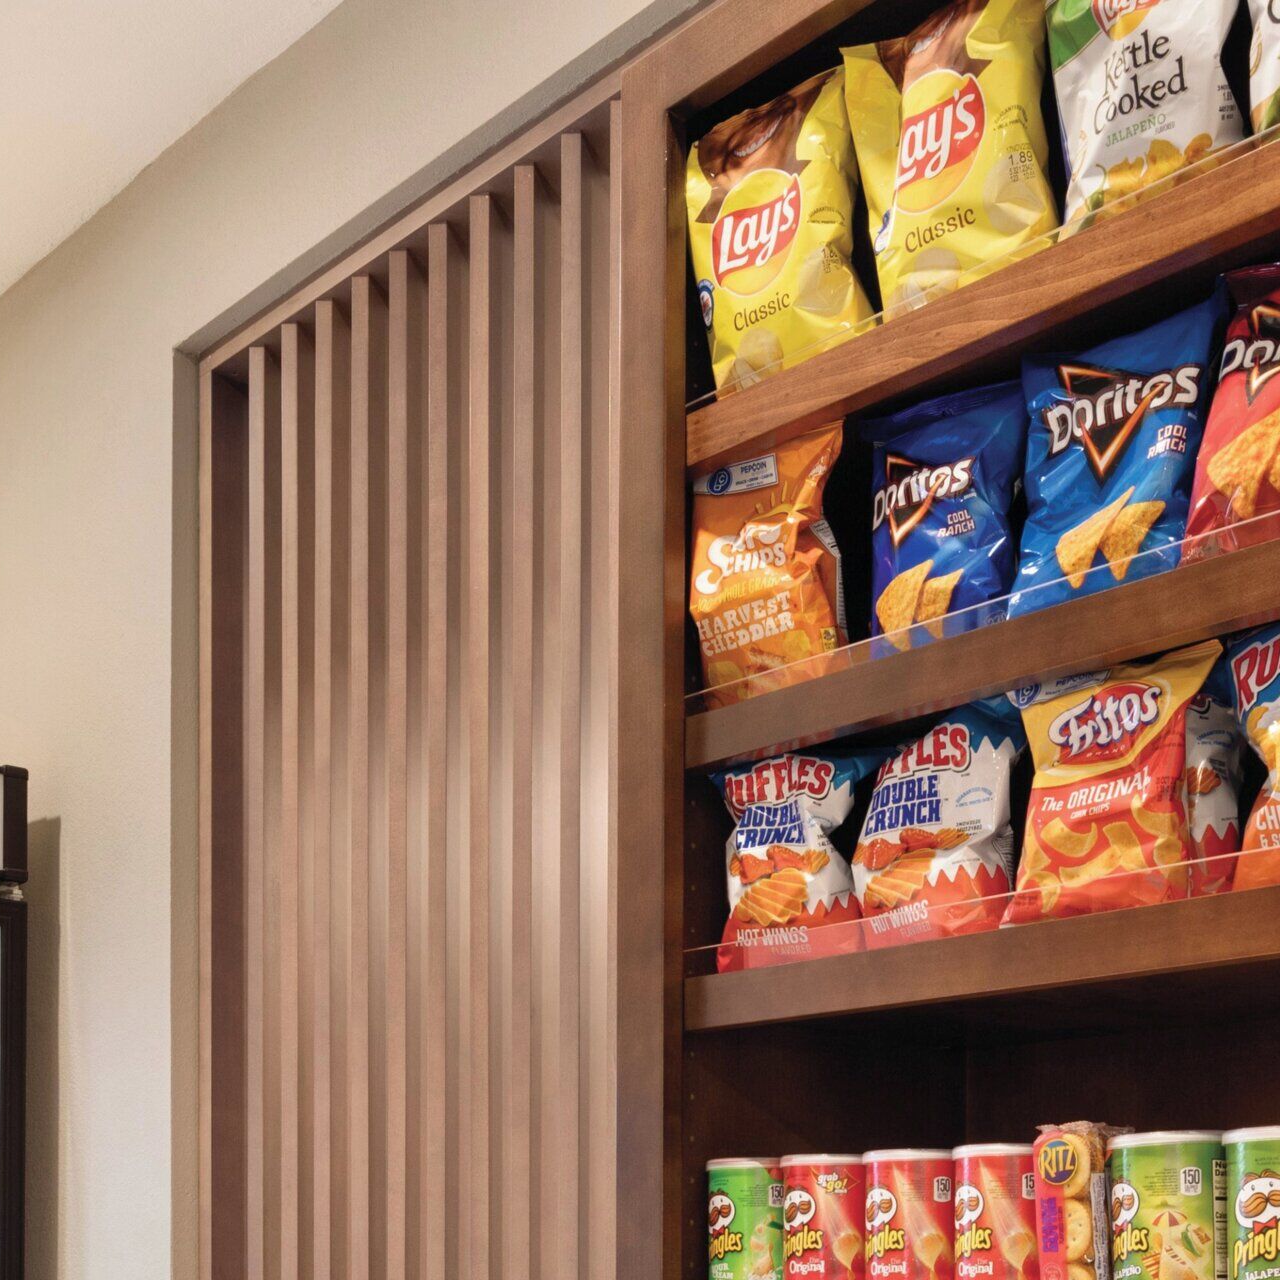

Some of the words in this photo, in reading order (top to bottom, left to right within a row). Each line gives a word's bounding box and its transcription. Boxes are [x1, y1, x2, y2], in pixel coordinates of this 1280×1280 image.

[1104, 29, 1169, 97] Kettle
[1094, 55, 1187, 134] Cooked
[718, 186, 797, 275] Lay's
[905, 207, 976, 253] Classic
[734, 291, 791, 332] Classic
[1046, 366, 1200, 455] Doritos
[872, 459, 972, 532] Doritos
[937, 521, 976, 538] RANCH
[947, 509, 971, 525] COOL
[697, 591, 791, 641] HARVEST
[702, 611, 795, 657] CHEDDAR
[1049, 686, 1162, 757] Fritos
[871, 773, 939, 814] DOUBLE
[1041, 795, 1064, 812] The
[1089, 802, 1111, 817] CHIPS
[865, 798, 941, 838] CRUNCH
[1040, 1146, 1077, 1178] RITZ
[1183, 1169, 1201, 1185] 150
[936, 1178, 951, 1193] 150
[789, 1261, 826, 1275] Original
[871, 1261, 907, 1276] Original
[958, 1261, 994, 1276] Original
